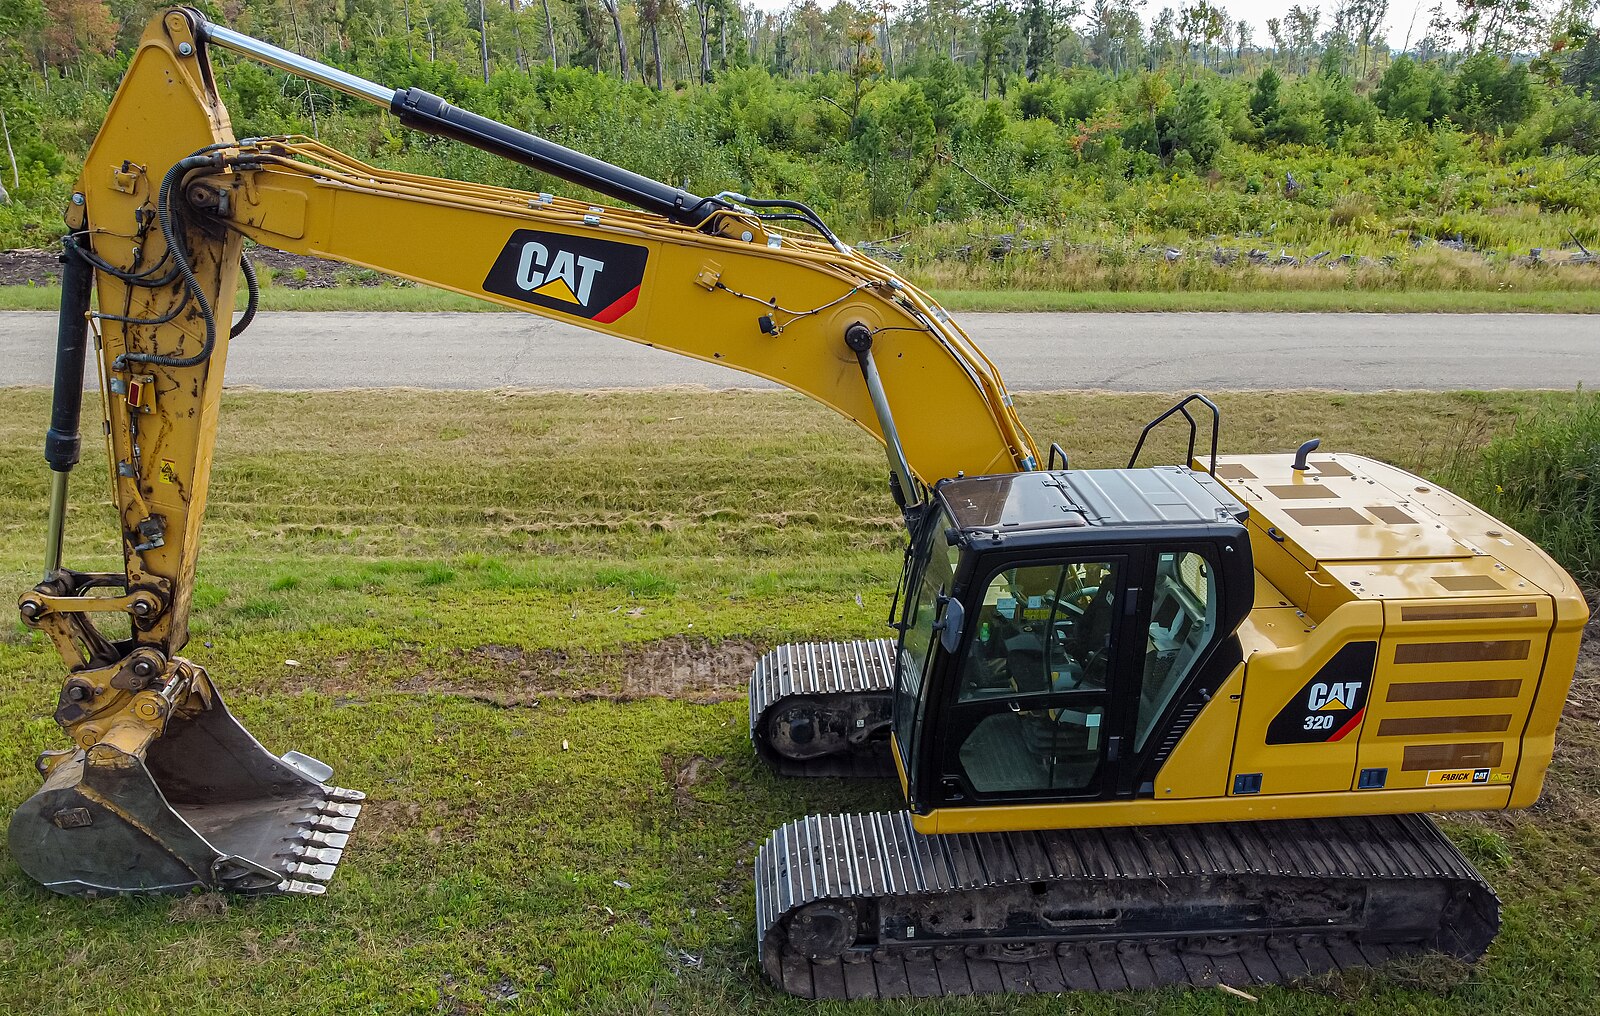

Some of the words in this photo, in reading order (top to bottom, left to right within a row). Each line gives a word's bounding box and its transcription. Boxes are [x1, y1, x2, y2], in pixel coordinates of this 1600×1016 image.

[516, 241, 604, 307] CAT
[1308, 682, 1362, 711] CAT
[1303, 715, 1334, 730] 320
[1440, 773, 1470, 781] FABICK
[1474, 772, 1488, 780] CAT
